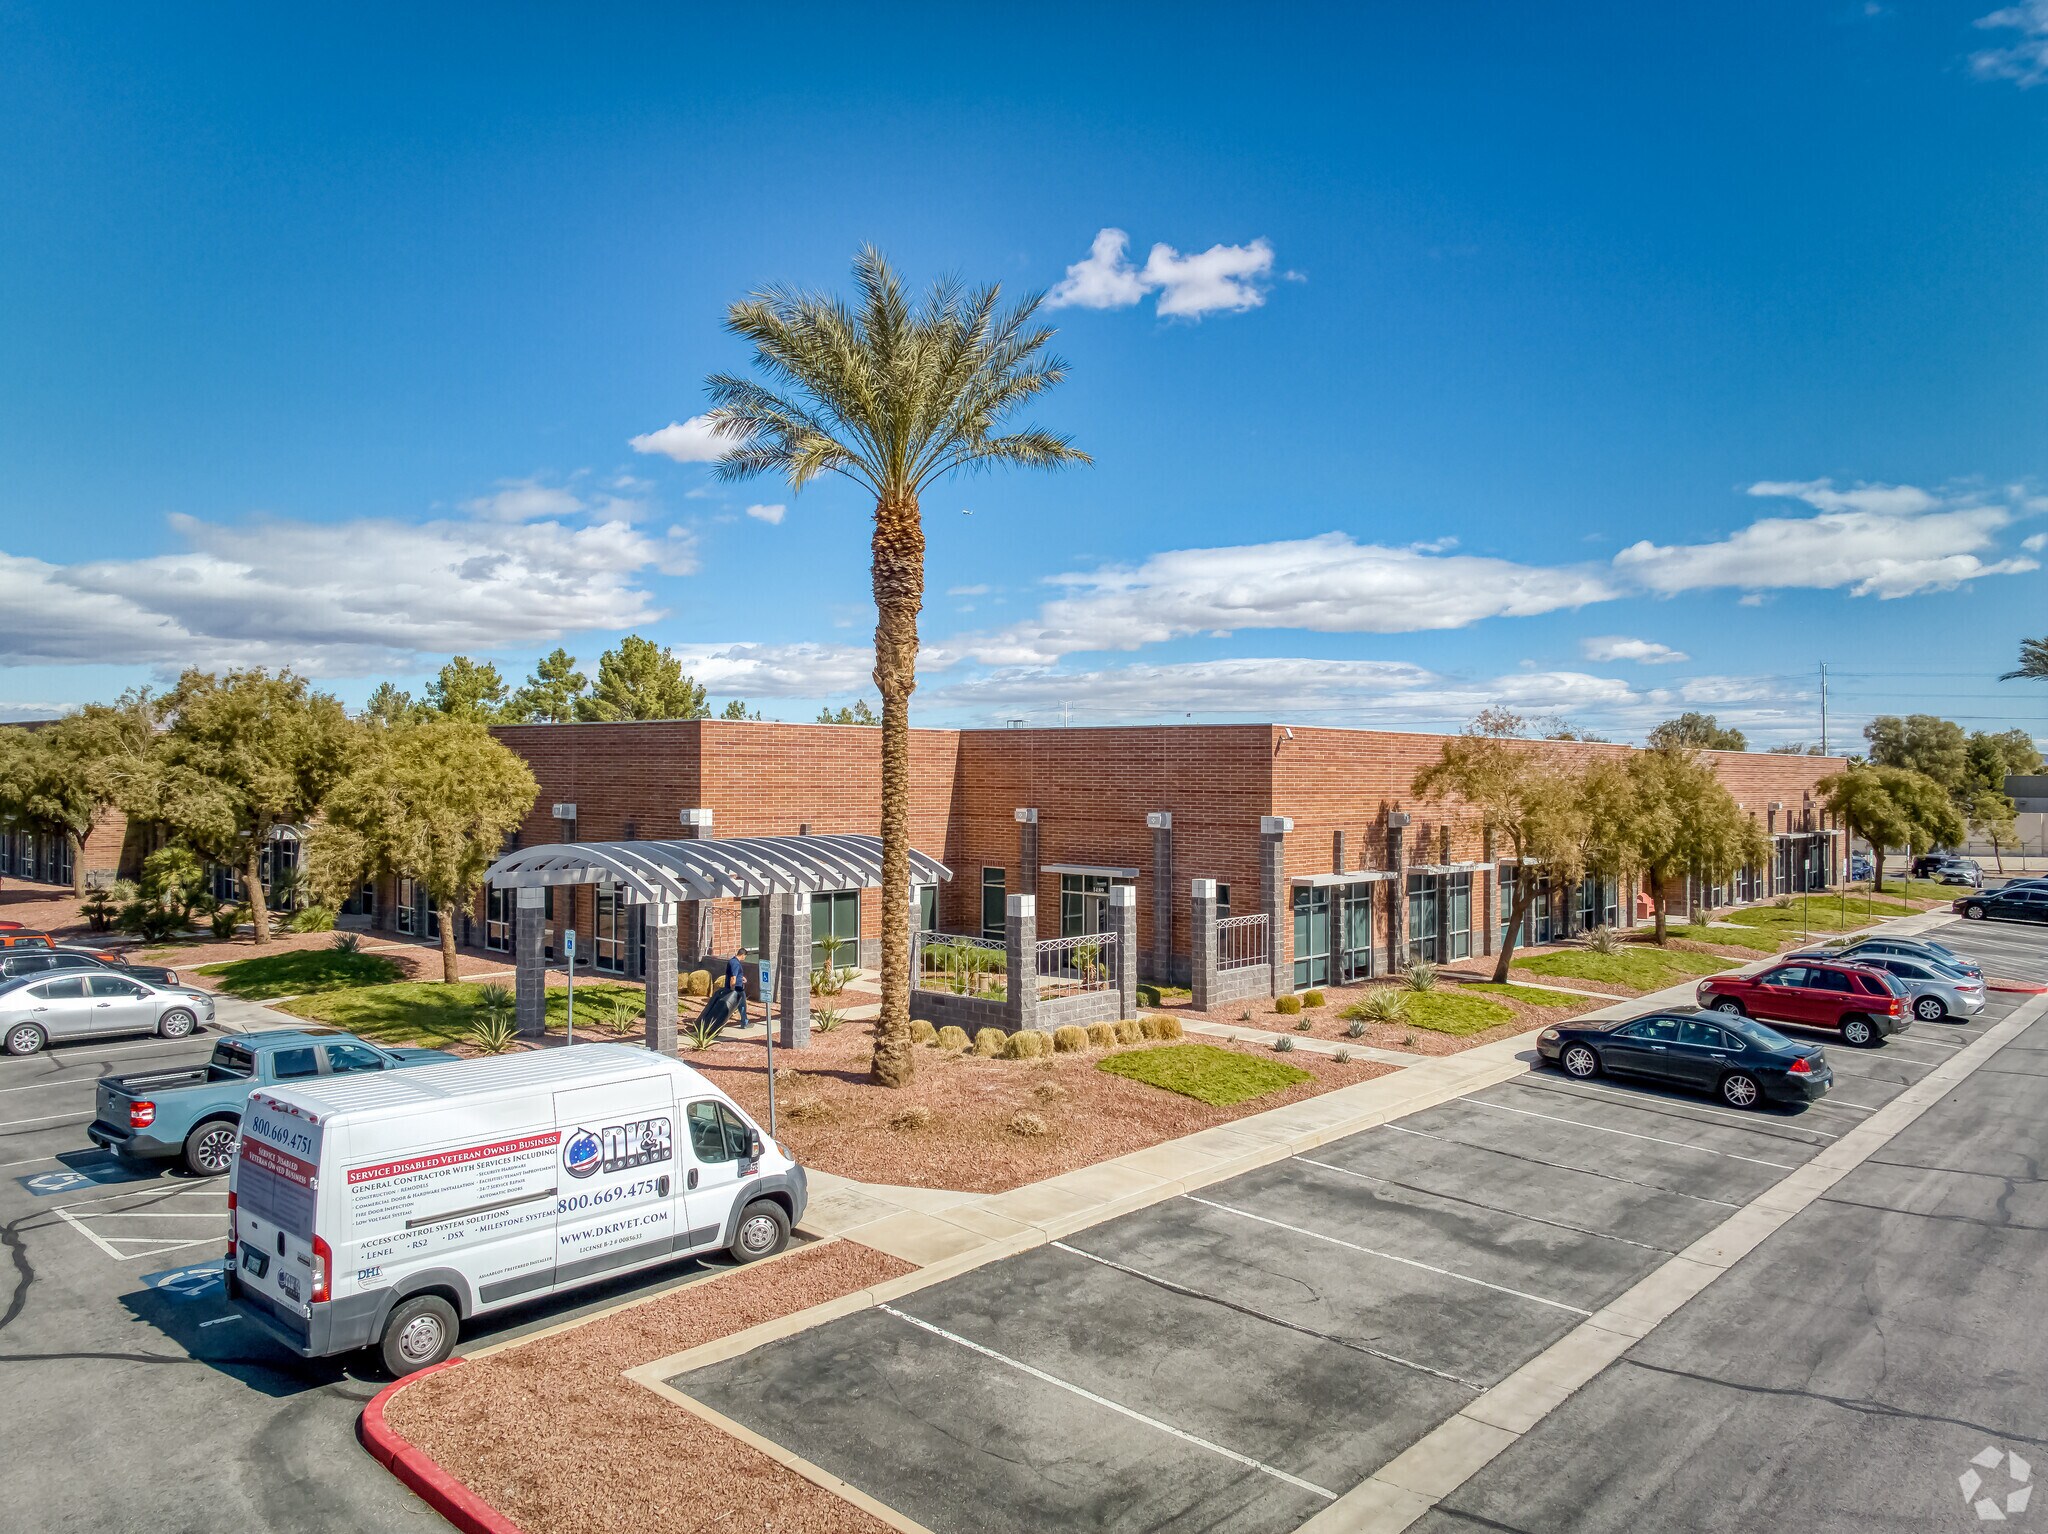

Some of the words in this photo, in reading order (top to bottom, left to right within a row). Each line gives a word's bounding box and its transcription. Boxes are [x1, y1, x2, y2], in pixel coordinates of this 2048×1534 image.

[252, 1116, 312, 1154] 800.669.4751
[601, 1116, 672, 1174] DK&R
[249, 1152, 268, 1166] VETERAN
[285, 1170, 306, 1184] BUSINESS
[258, 1147, 276, 1162] SERVICE
[350, 1167, 390, 1182] SERVICE
[393, 1158, 439, 1174] DISABLED
[440, 1150, 481, 1164] VETERAN
[483, 1144, 517, 1156] OWNED
[519, 1136, 556, 1149] BUSINESS
[352, 1180, 391, 1194] GENERAL
[393, 1169, 451, 1186] CONTRACTOR
[453, 1164, 475, 1174] WITH
[476, 1156, 511, 1170] SERVICES
[412, 1189, 440, 1198] HARDWARE
[441, 1182, 474, 1192] INSTALLATION
[355, 1190, 396, 1202] CONSTRUCTION
[400, 1183, 429, 1193] REMODELS
[384, 1202, 414, 1212] INSPECTION
[558, 1178, 660, 1214] 800.669.4751
[360, 1237, 392, 1250] ACCESS
[394, 1226, 434, 1242] CONTROL
[436, 1220, 464, 1232] SYSTEM
[466, 1210, 510, 1224] SOLUTIONS
[366, 1248, 394, 1260] LENEL
[412, 1239, 428, 1249] RS2
[448, 1230, 464, 1240] DSX
[480, 1216, 524, 1232] MILESTONE
[526, 1209, 556, 1222] SYSTEMS
[560, 1211, 668, 1245] WWW.DKRVET.COM
[580, 1242, 602, 1253] LICENSE
[358, 1265, 380, 1280] DHI
